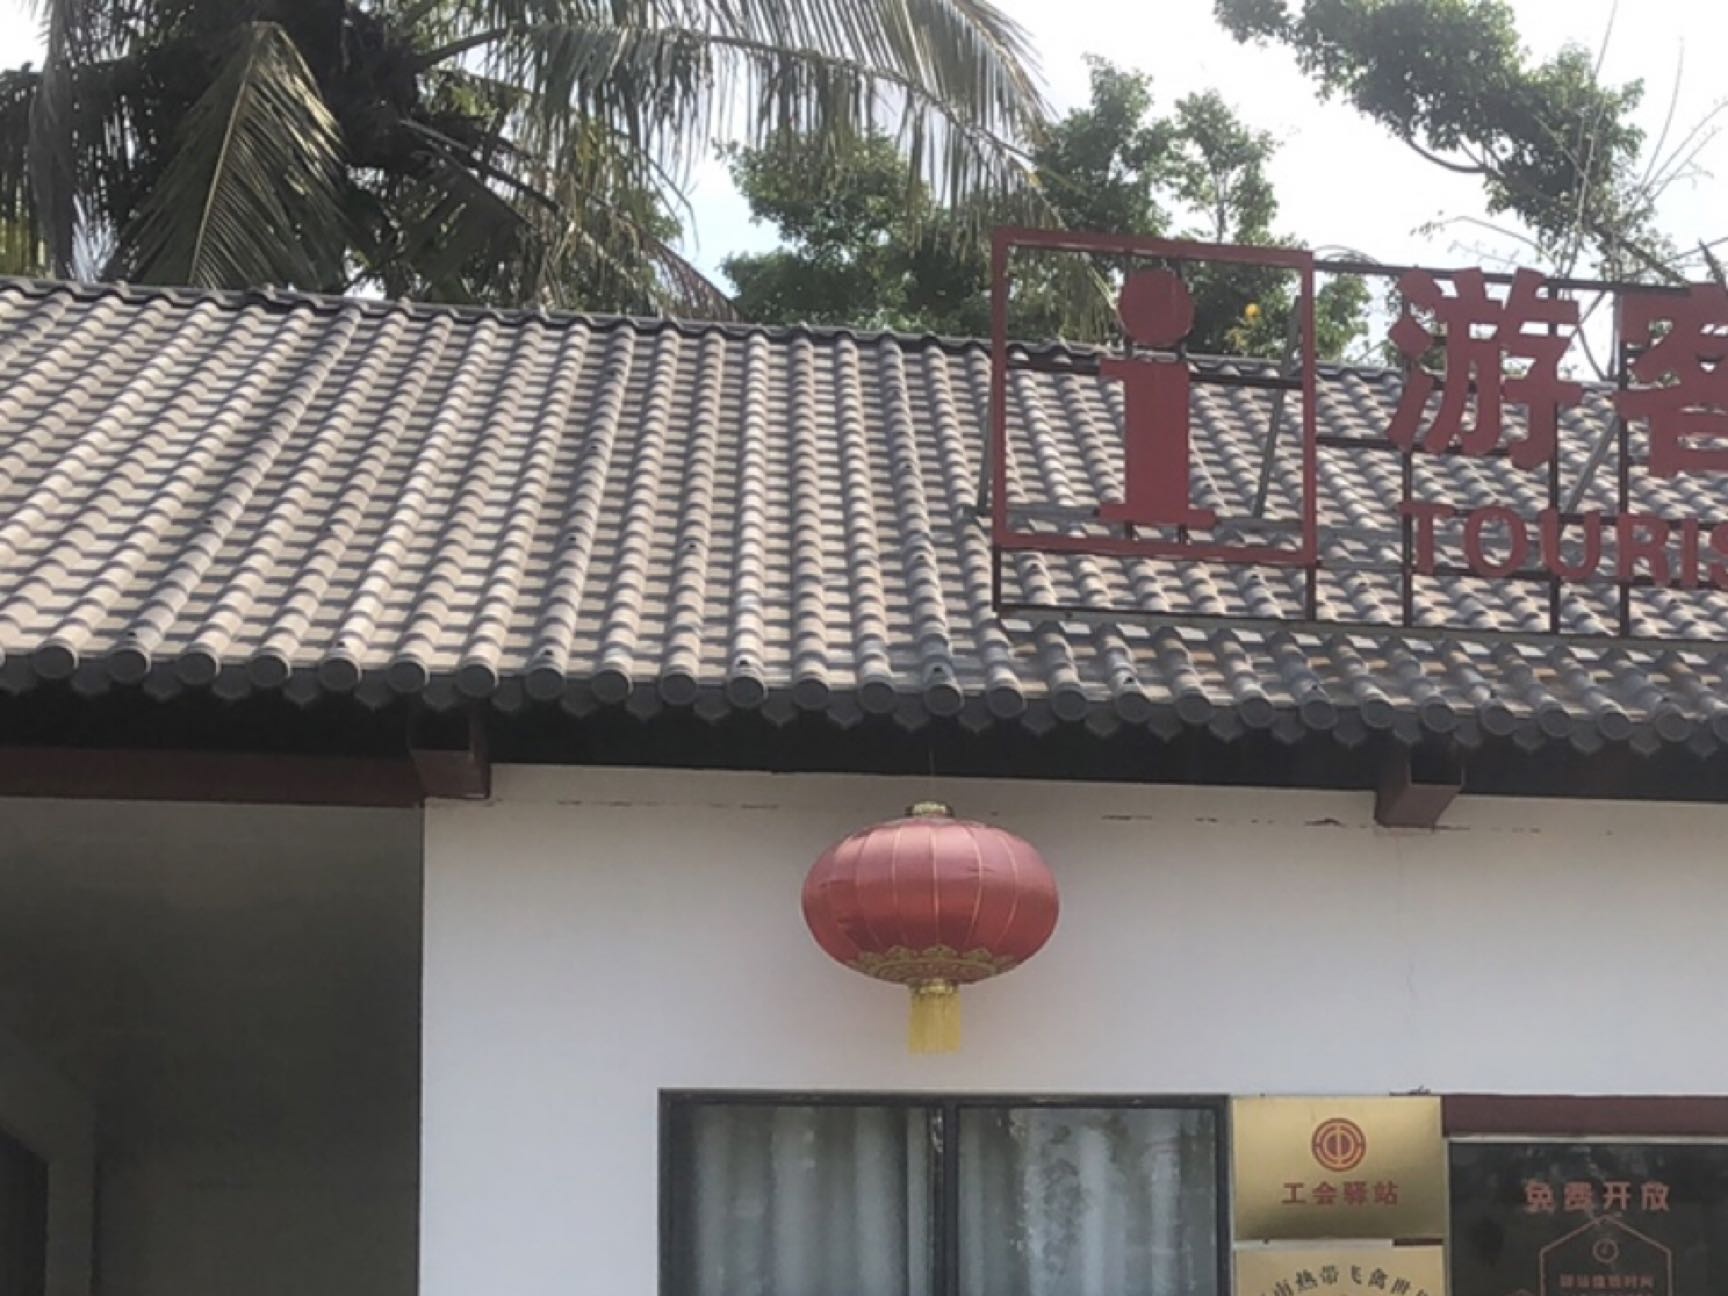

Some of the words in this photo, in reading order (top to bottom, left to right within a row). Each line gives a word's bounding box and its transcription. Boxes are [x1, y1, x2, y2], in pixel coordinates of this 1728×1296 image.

[1281, 1180, 1400, 1206] 工会驿站
[1524, 1179, 1671, 1214] 免费开放
